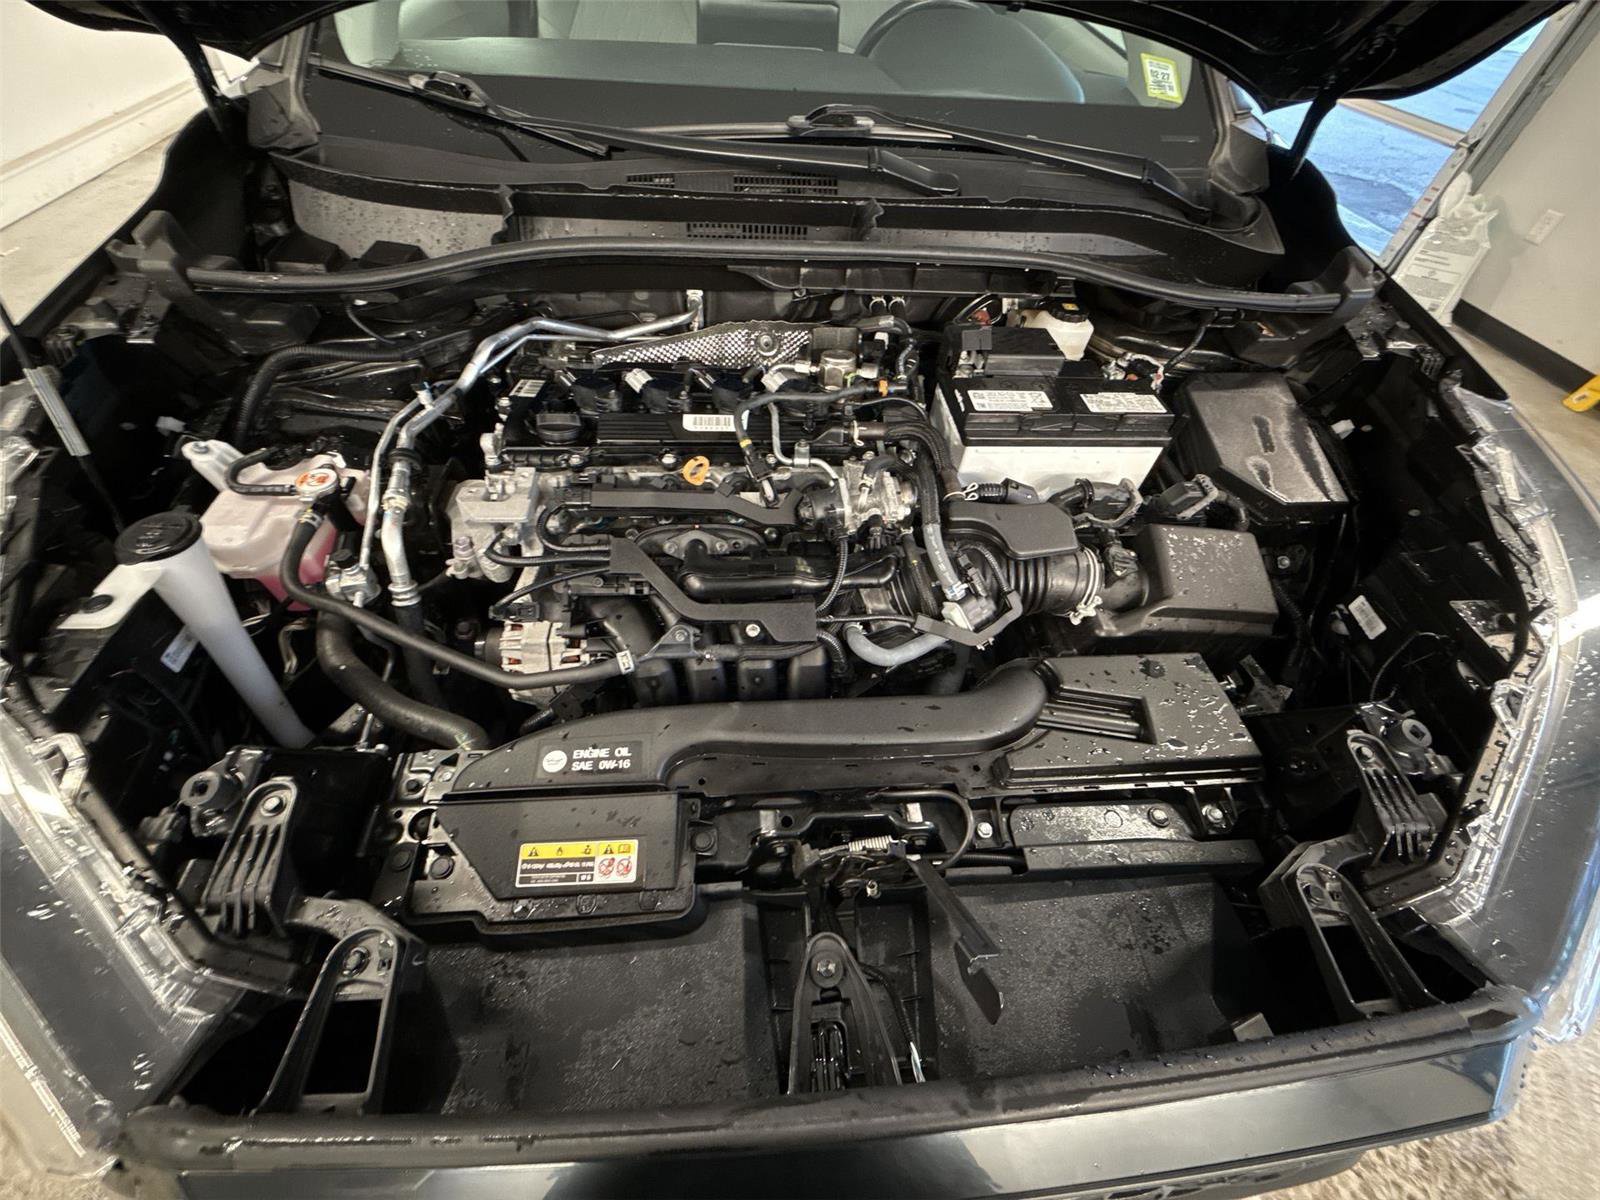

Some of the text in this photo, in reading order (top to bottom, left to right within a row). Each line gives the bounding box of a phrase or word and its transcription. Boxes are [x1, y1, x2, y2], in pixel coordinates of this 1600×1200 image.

[573, 746, 632, 759] ENGINE OIL
[571, 759, 631, 771] SAE 0W-16
